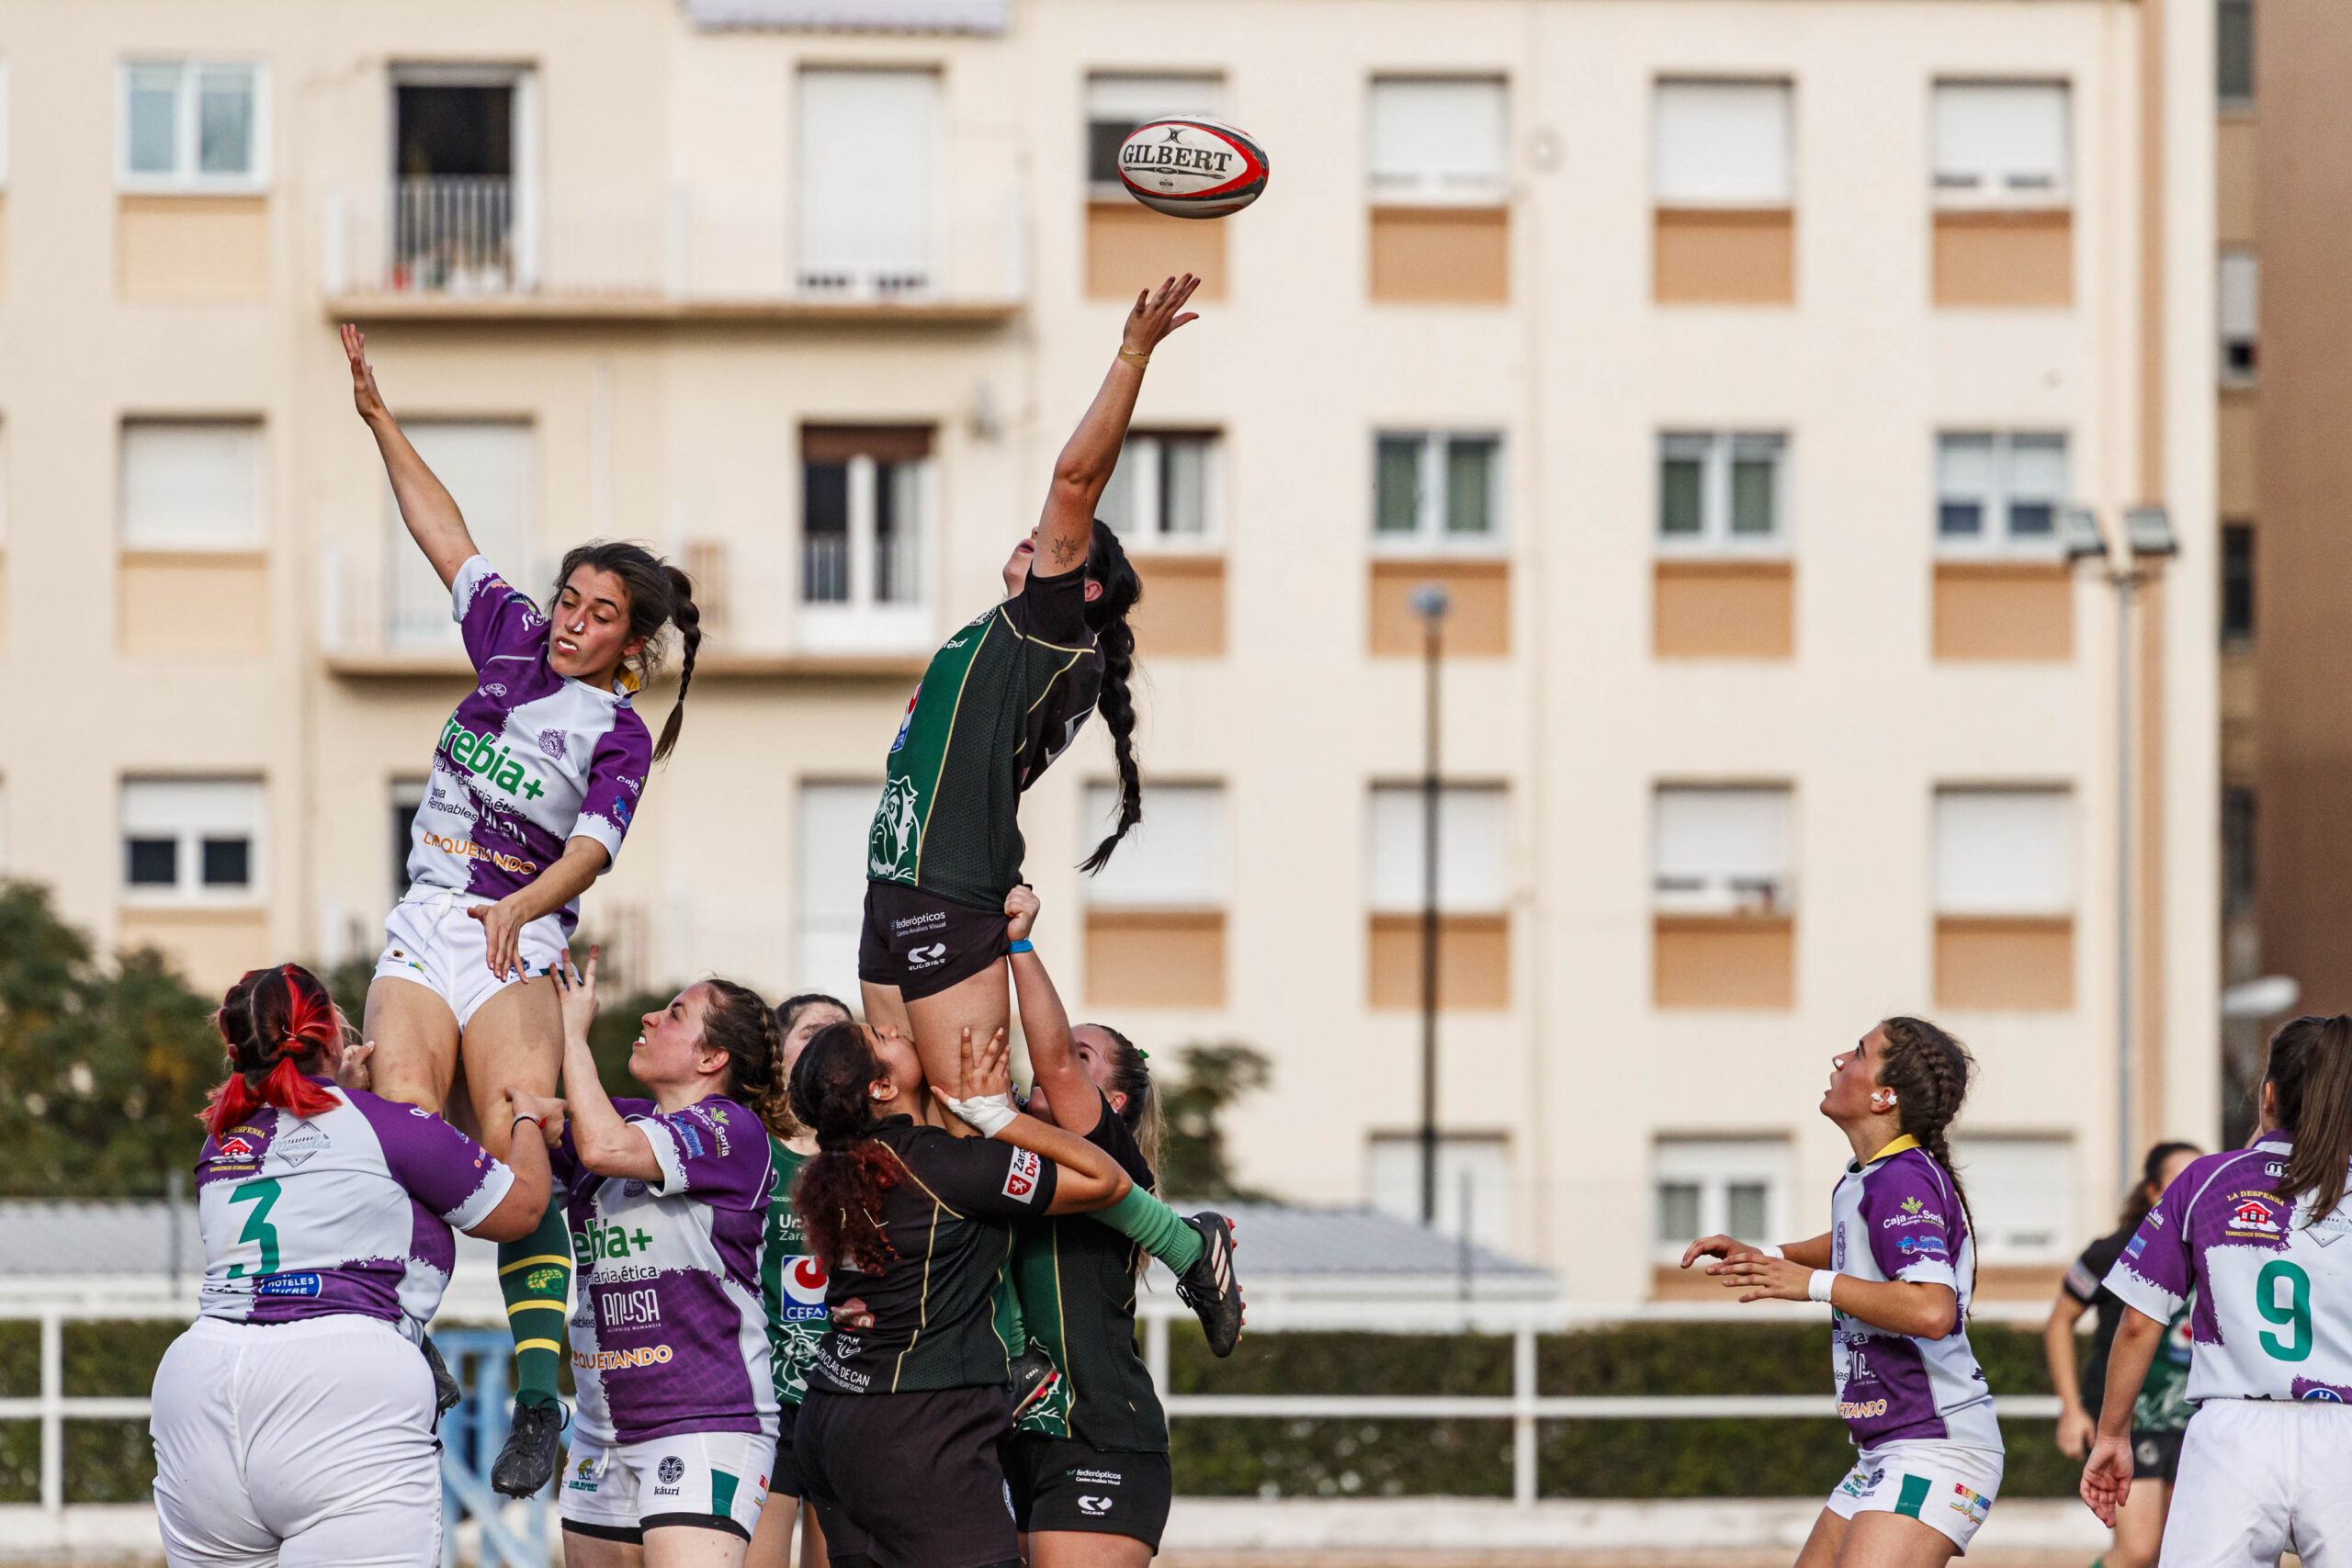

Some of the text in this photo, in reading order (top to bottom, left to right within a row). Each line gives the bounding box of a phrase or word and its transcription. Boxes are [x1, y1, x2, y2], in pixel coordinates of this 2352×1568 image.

[1123, 143, 1233, 173] GILBERT
[616, 775, 639, 790] Caja
[715, 1125, 731, 1157] Soria
[2226, 1190, 2285, 1207] LA DESPENSA
[228, 1179, 282, 1280] 3
[1883, 1214, 1907, 1229] Caja
[572, 1218, 654, 1266] ebia+
[620, 1265, 658, 1281] ética
[602, 1288, 661, 1326] ANUSA
[786, 1306, 823, 1321] CEFA
[2256, 1259, 2313, 1363] 9
[840, 1366, 852, 1380] DE
[850, 1371, 871, 1387] CAN
[1076, 1469, 1122, 1480] federópticos
